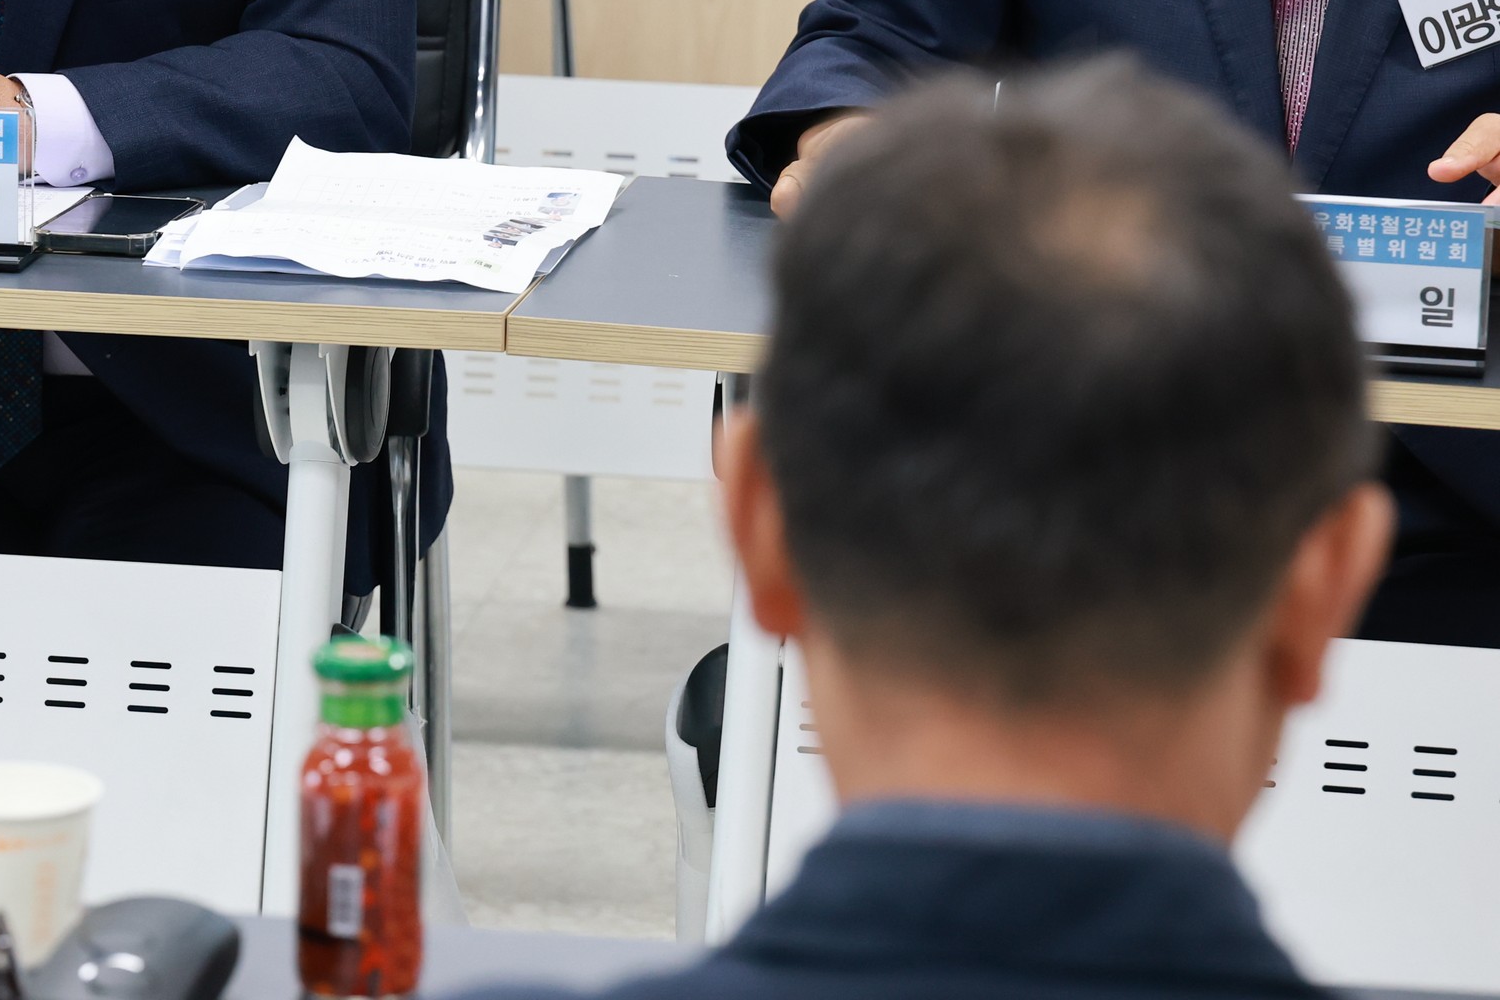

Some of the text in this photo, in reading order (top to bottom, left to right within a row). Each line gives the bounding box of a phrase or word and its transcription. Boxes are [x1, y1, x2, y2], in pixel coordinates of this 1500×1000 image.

[1314, 211, 1469, 240] 유화학철강산업
[1326, 235, 1468, 263] 특별위원회
[1419, 286, 1456, 328] 일
